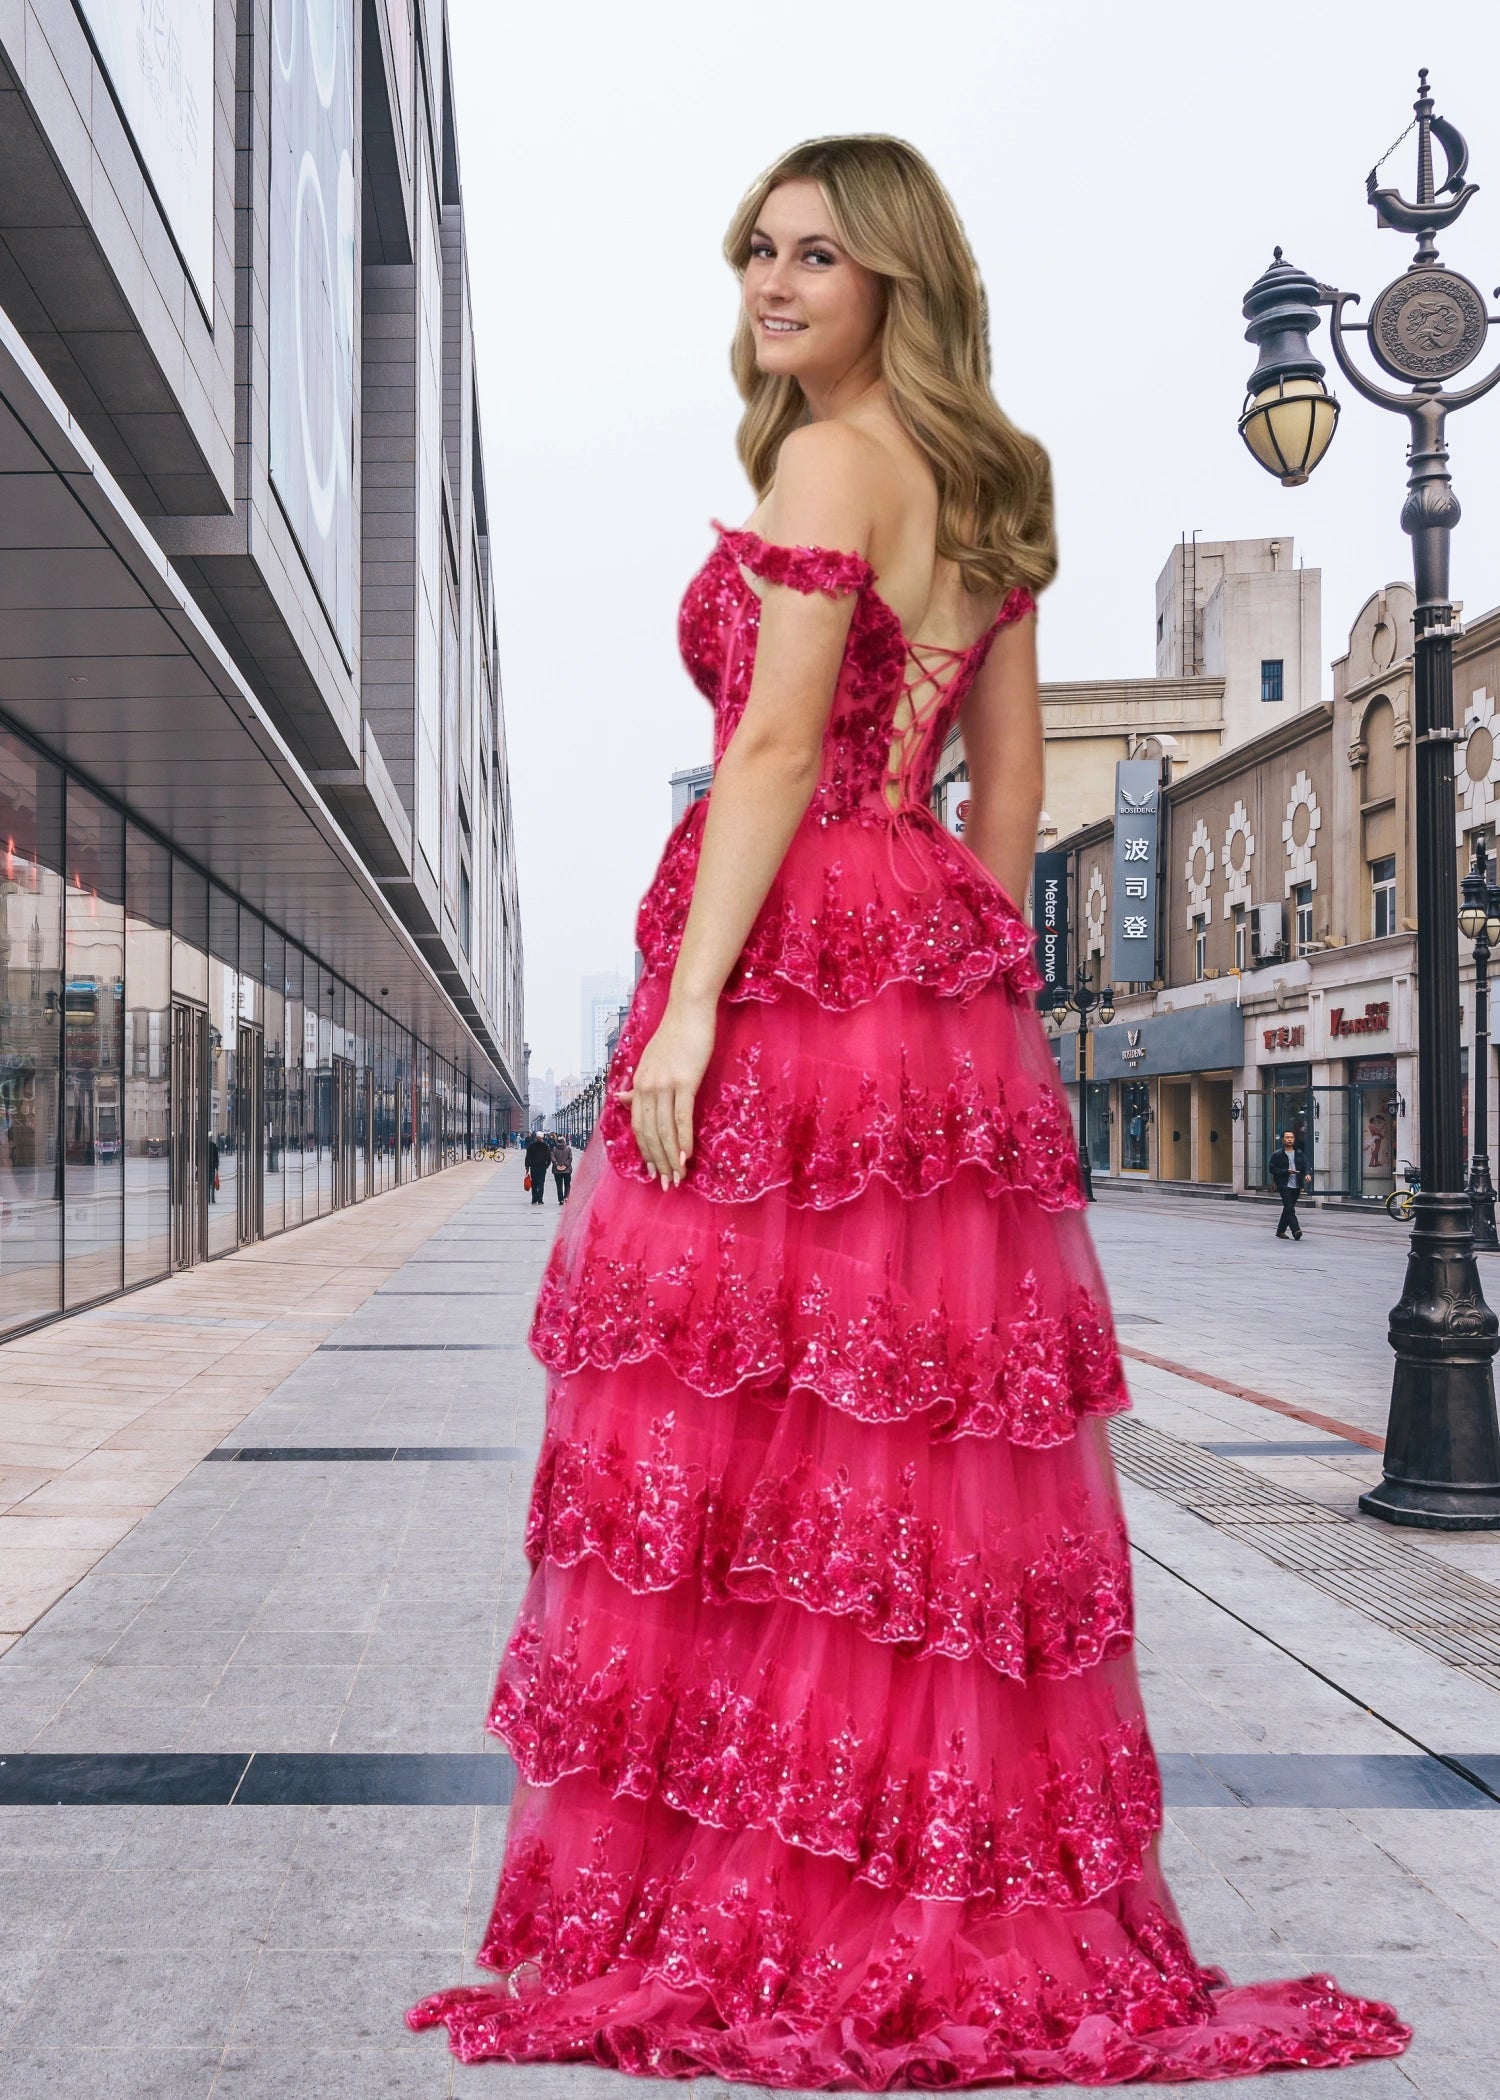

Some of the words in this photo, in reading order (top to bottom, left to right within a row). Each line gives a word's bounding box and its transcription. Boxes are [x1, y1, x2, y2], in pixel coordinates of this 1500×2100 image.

[1045, 879, 1058, 983] Meters/bonwe
[1123, 837, 1149, 939] 波司登
